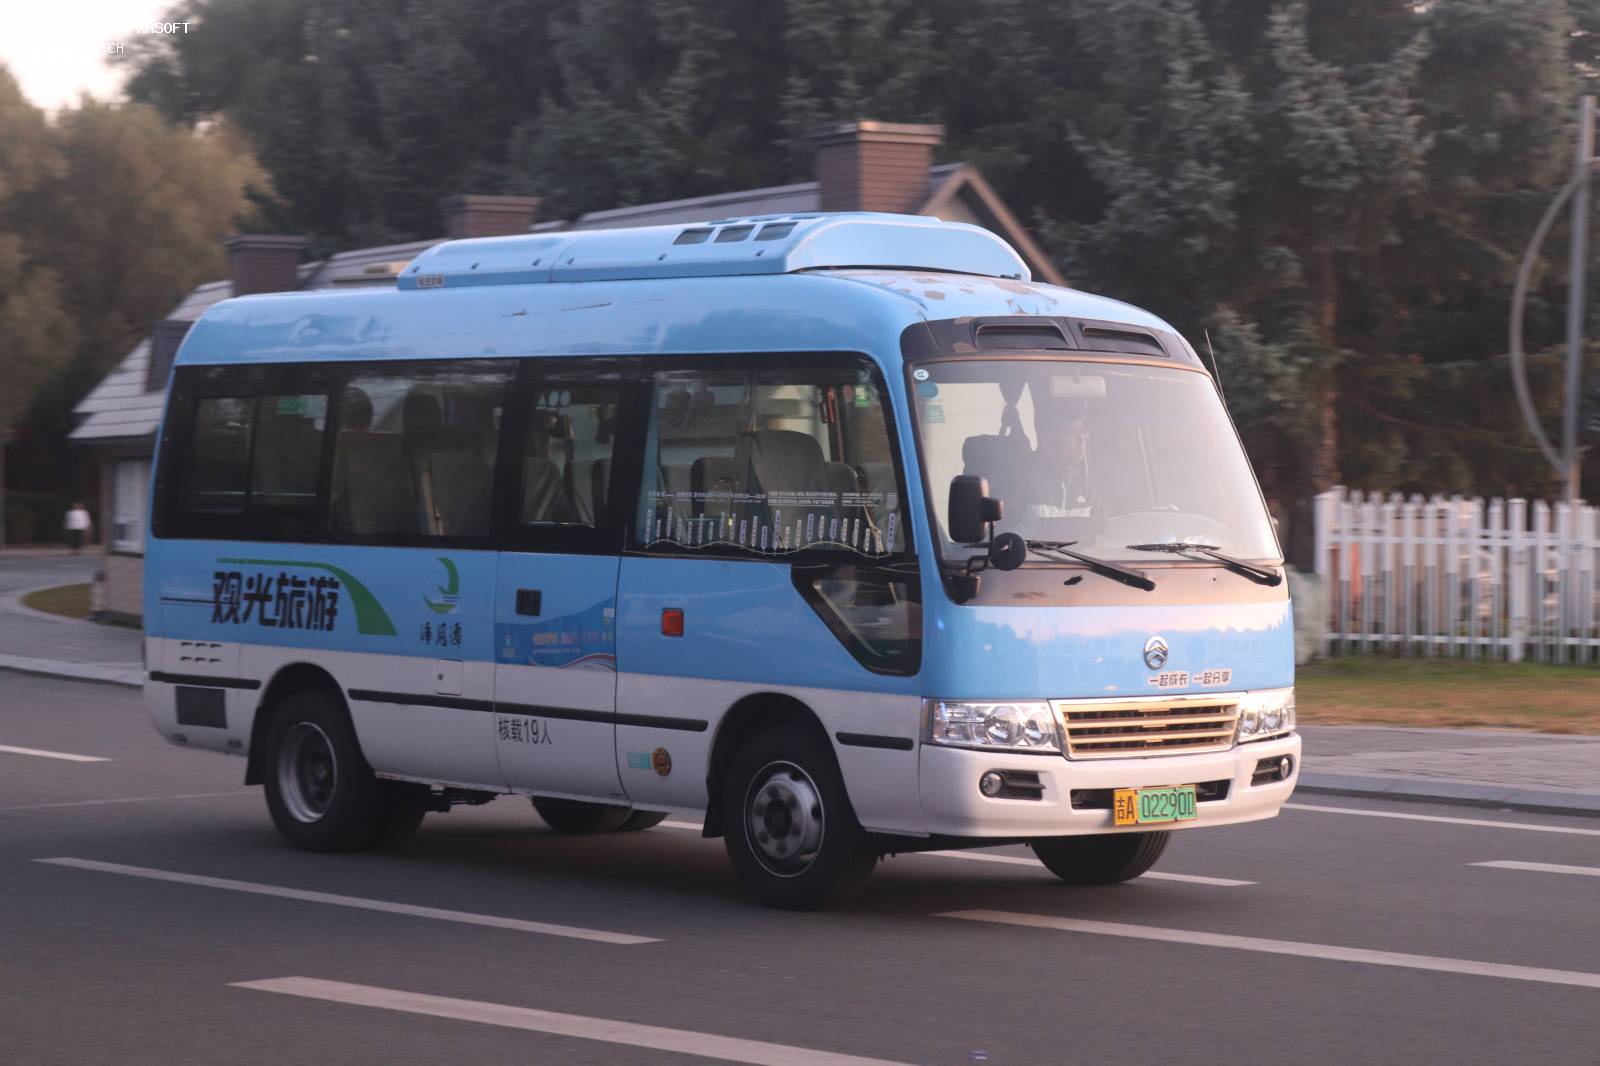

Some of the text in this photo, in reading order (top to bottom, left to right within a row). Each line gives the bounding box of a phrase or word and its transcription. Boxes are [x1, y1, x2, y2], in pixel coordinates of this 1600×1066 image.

[211, 571, 341, 632] 观光旅游
[1149, 671, 1230, 687] 一起成长 一起分享
[498, 717, 553, 745] 核载19人
[1116, 796, 1135, 820] 吉A
